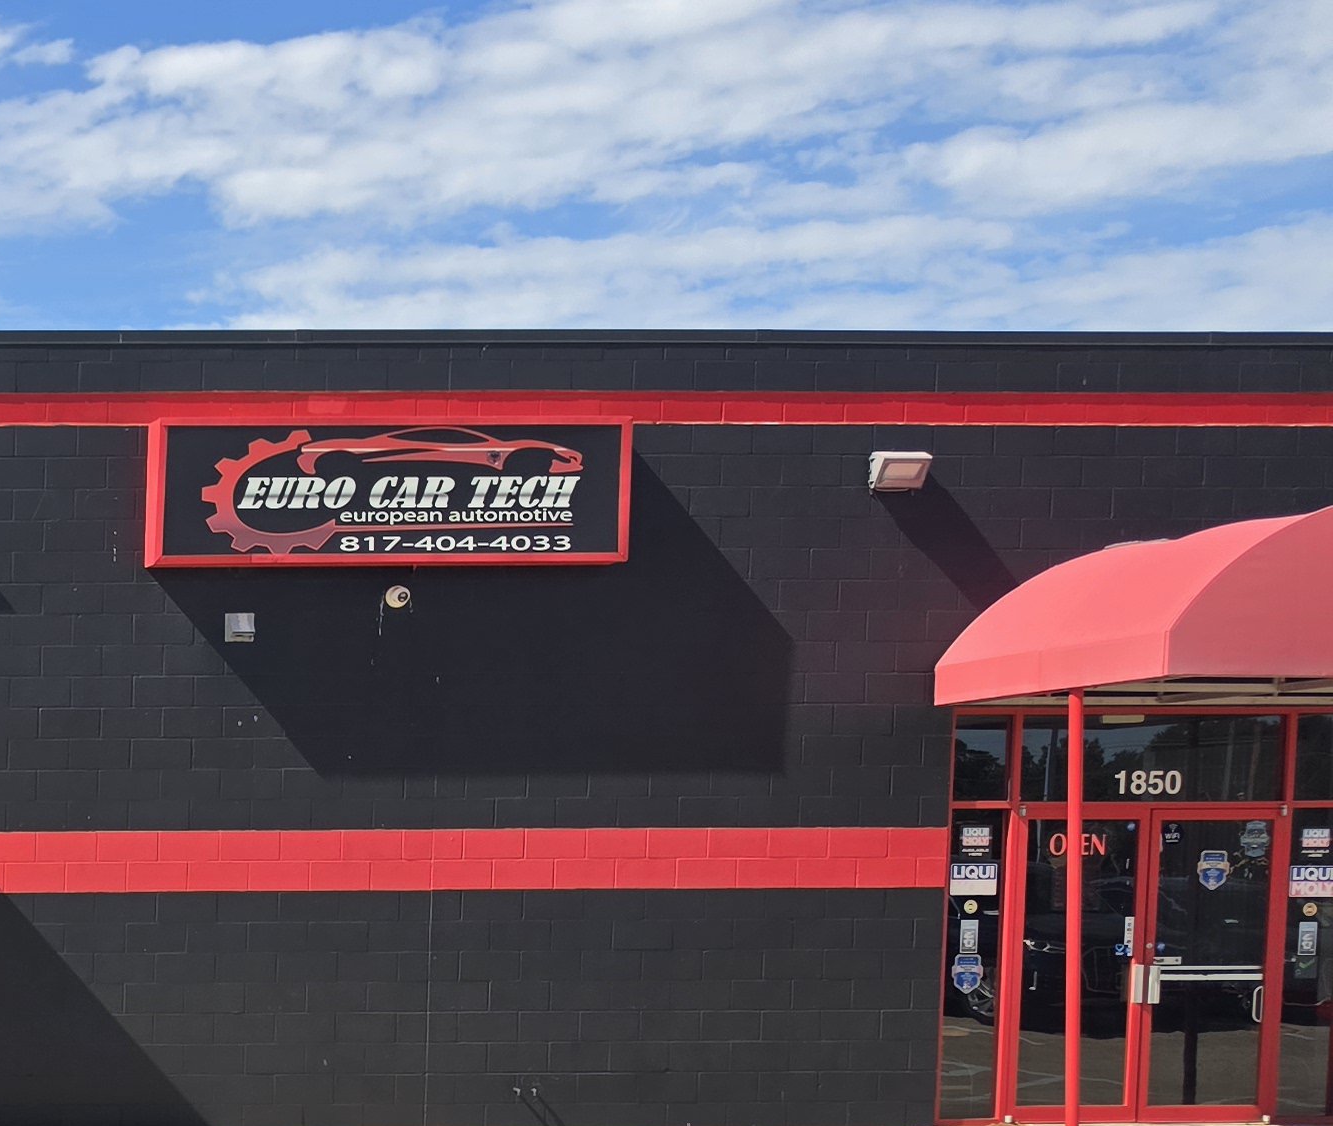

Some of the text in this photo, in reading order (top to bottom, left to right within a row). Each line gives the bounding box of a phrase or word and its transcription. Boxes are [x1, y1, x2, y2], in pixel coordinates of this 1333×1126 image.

[237, 476, 581, 509] EURO CAR TECH
[339, 507, 574, 525] european automotive
[339, 535, 572, 552] 817-404-4033
[1114, 769, 1182, 795] 1850
[1049, 833, 1107, 856] OEN
[953, 865, 995, 880] LIQUI
